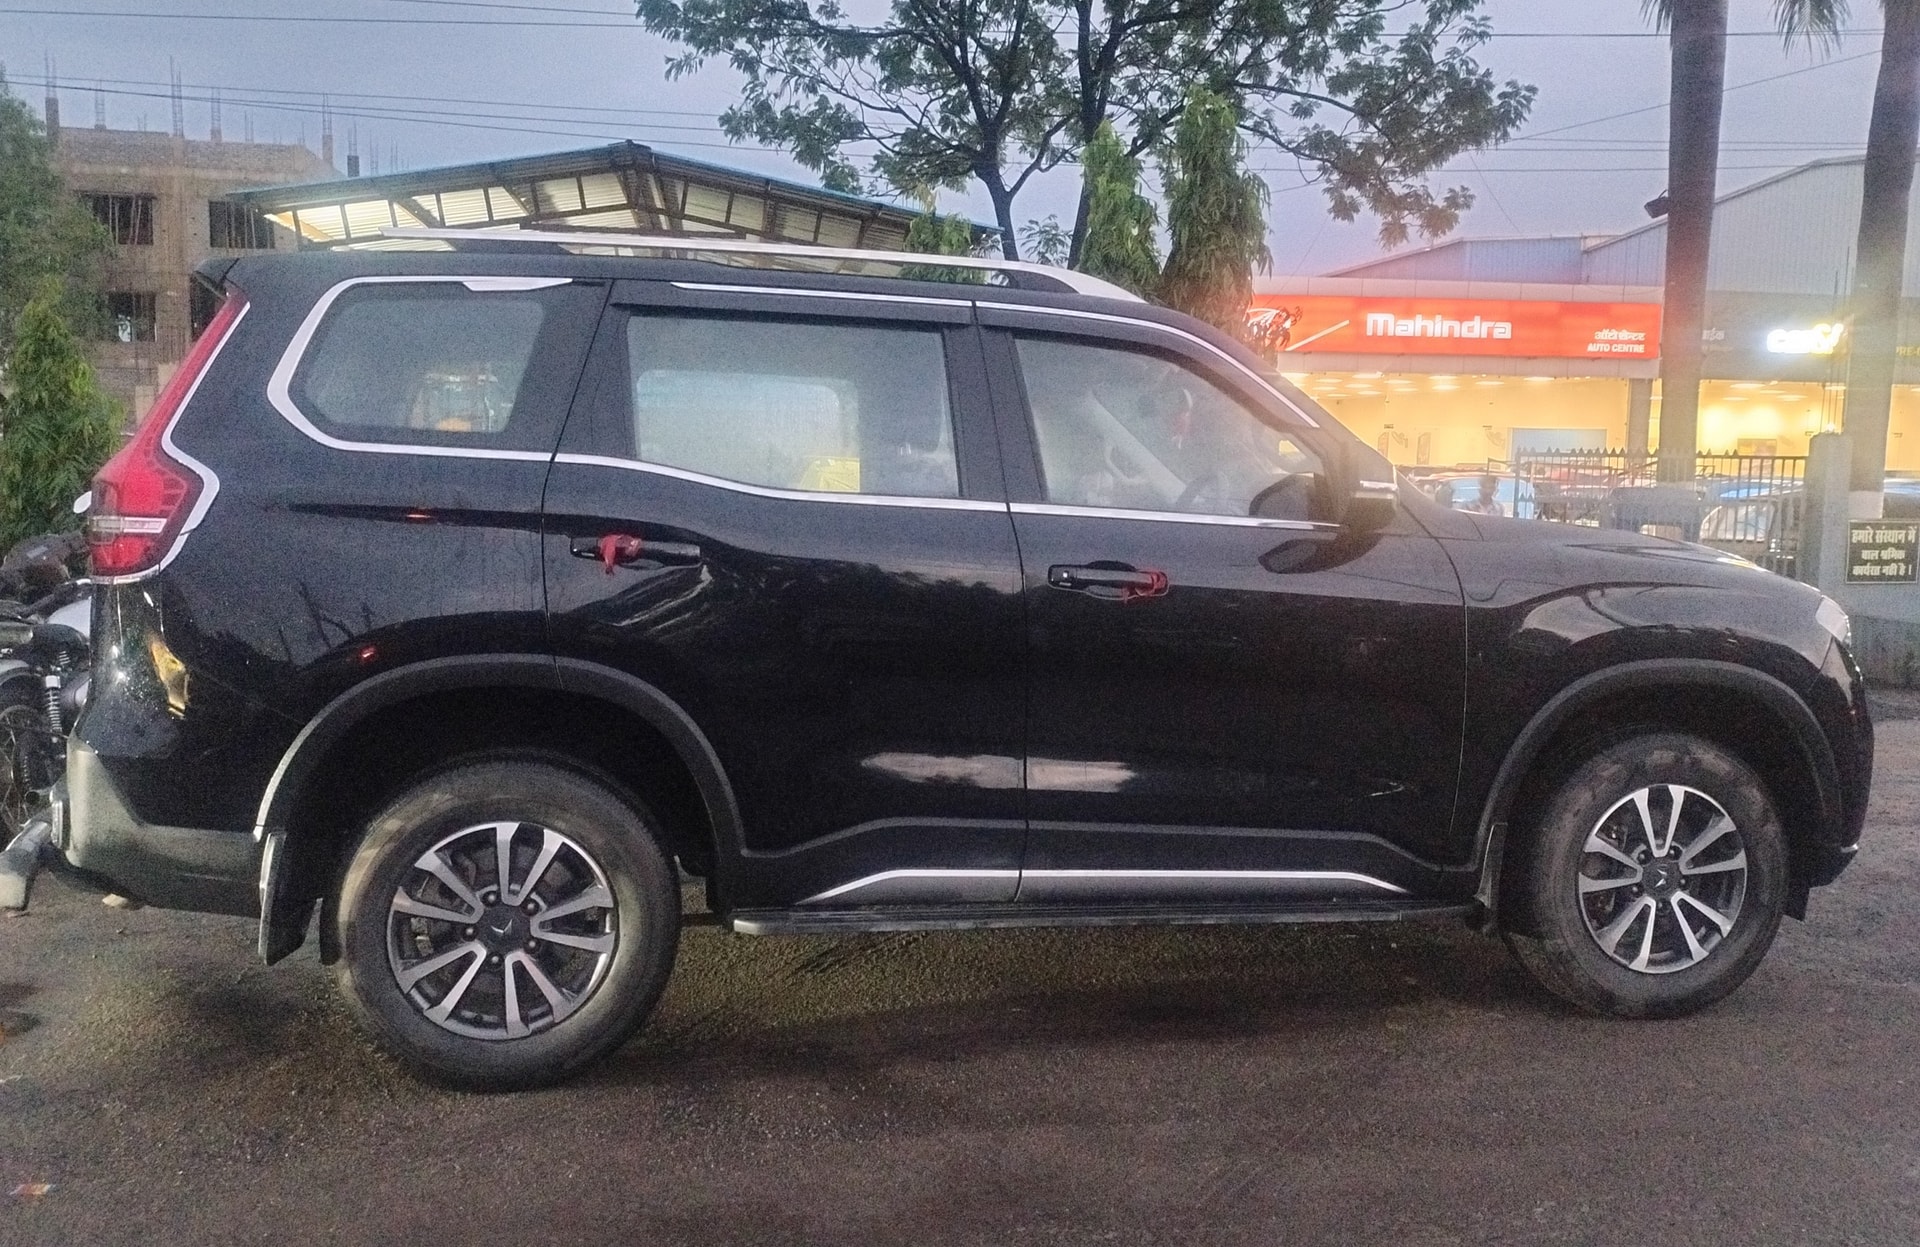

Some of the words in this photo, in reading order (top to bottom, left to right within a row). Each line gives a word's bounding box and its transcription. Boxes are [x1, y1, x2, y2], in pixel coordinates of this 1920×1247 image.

[1366, 312, 1512, 339] Mahindra
[1587, 343, 1610, 353] AUTO
[1611, 343, 1645, 353] CENTRE
[1851, 526, 1874, 543] हमारे
[1875, 526, 1906, 543] संस्थान
[1907, 526, 1917, 543] में
